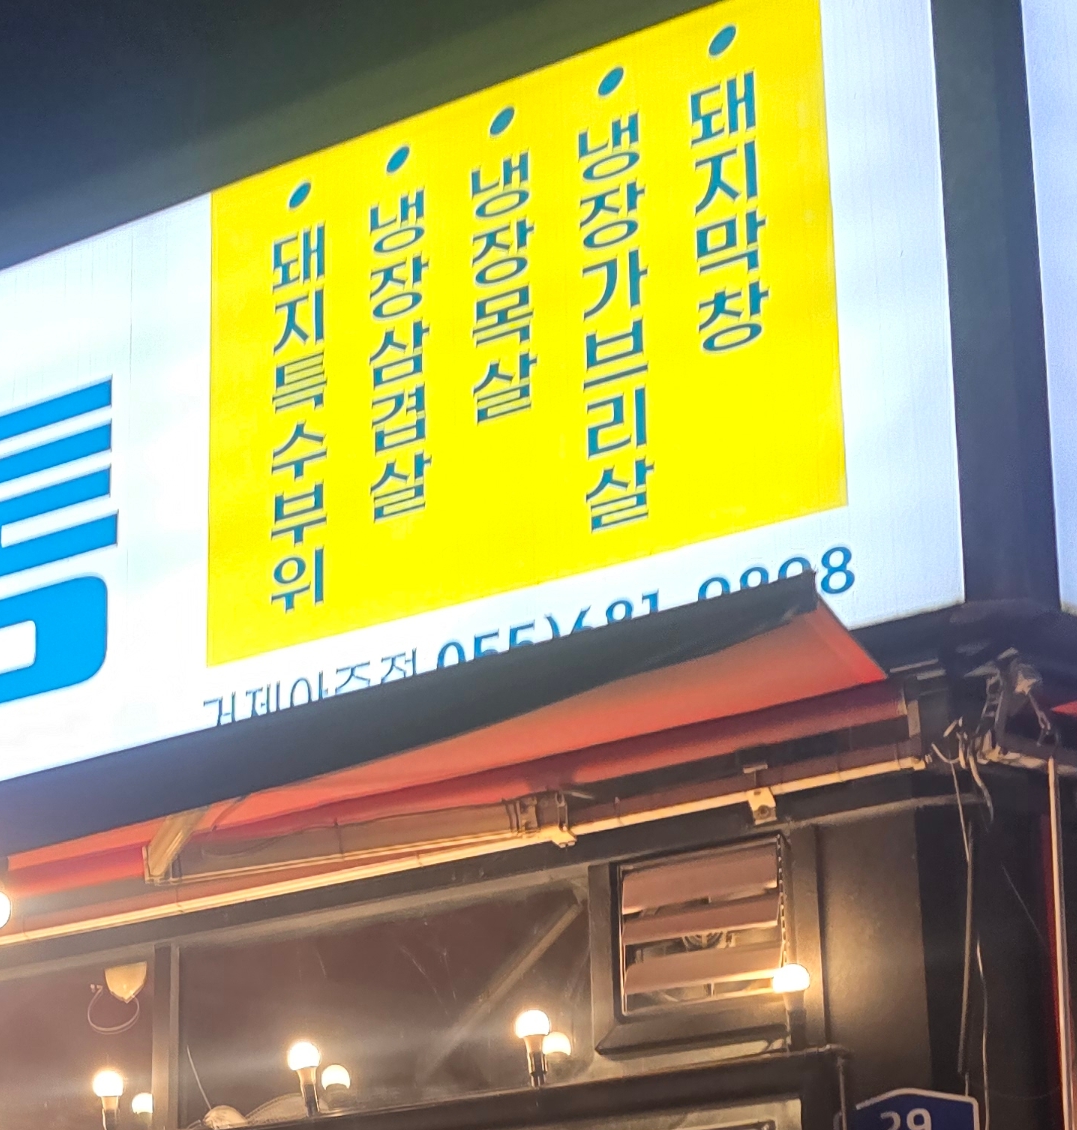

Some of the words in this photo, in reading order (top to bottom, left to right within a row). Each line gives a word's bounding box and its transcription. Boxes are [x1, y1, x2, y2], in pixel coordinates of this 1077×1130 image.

[368, 189, 433, 522] 냉장삼겹살
[470, 148, 537, 425] 냉장목살
[578, 111, 655, 535] 냉장가브리살
[689, 70, 770, 353] 돼지막창
[270, 220, 327, 611] 돼지특수부위
